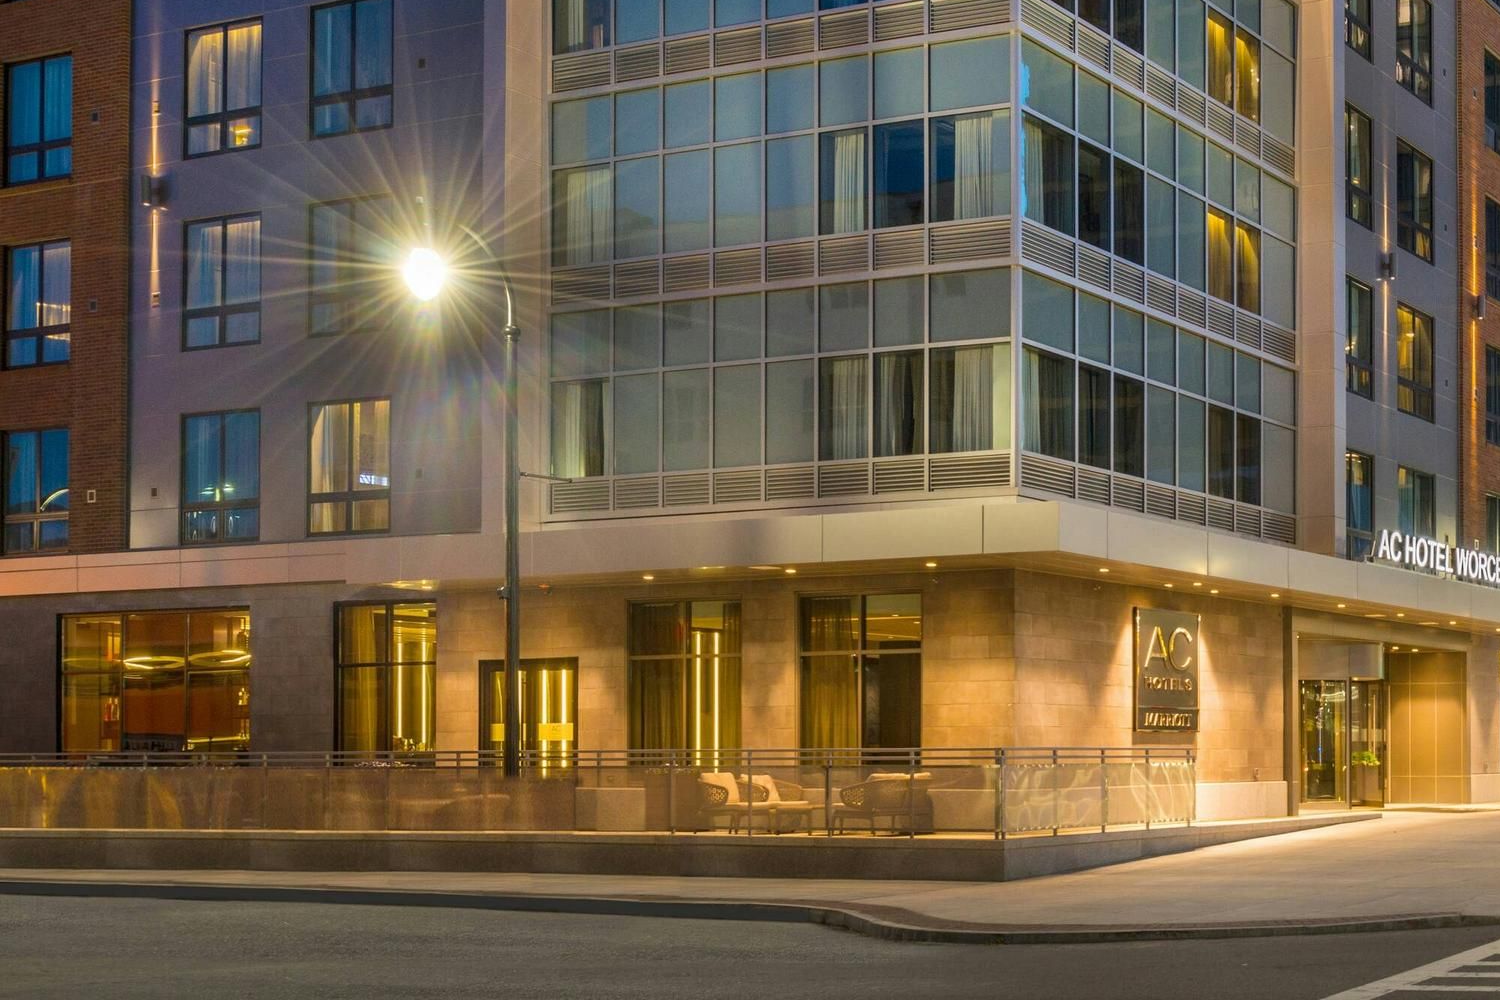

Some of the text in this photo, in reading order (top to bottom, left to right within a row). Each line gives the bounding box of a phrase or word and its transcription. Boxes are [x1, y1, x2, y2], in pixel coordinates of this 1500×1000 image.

[1378, 529, 1403, 563] AC
[1405, 534, 1454, 574] HOTEL
[1144, 625, 1193, 671] AC
[1143, 676, 1193, 691] HOTELS
[1143, 712, 1193, 727] MARRIOTT
